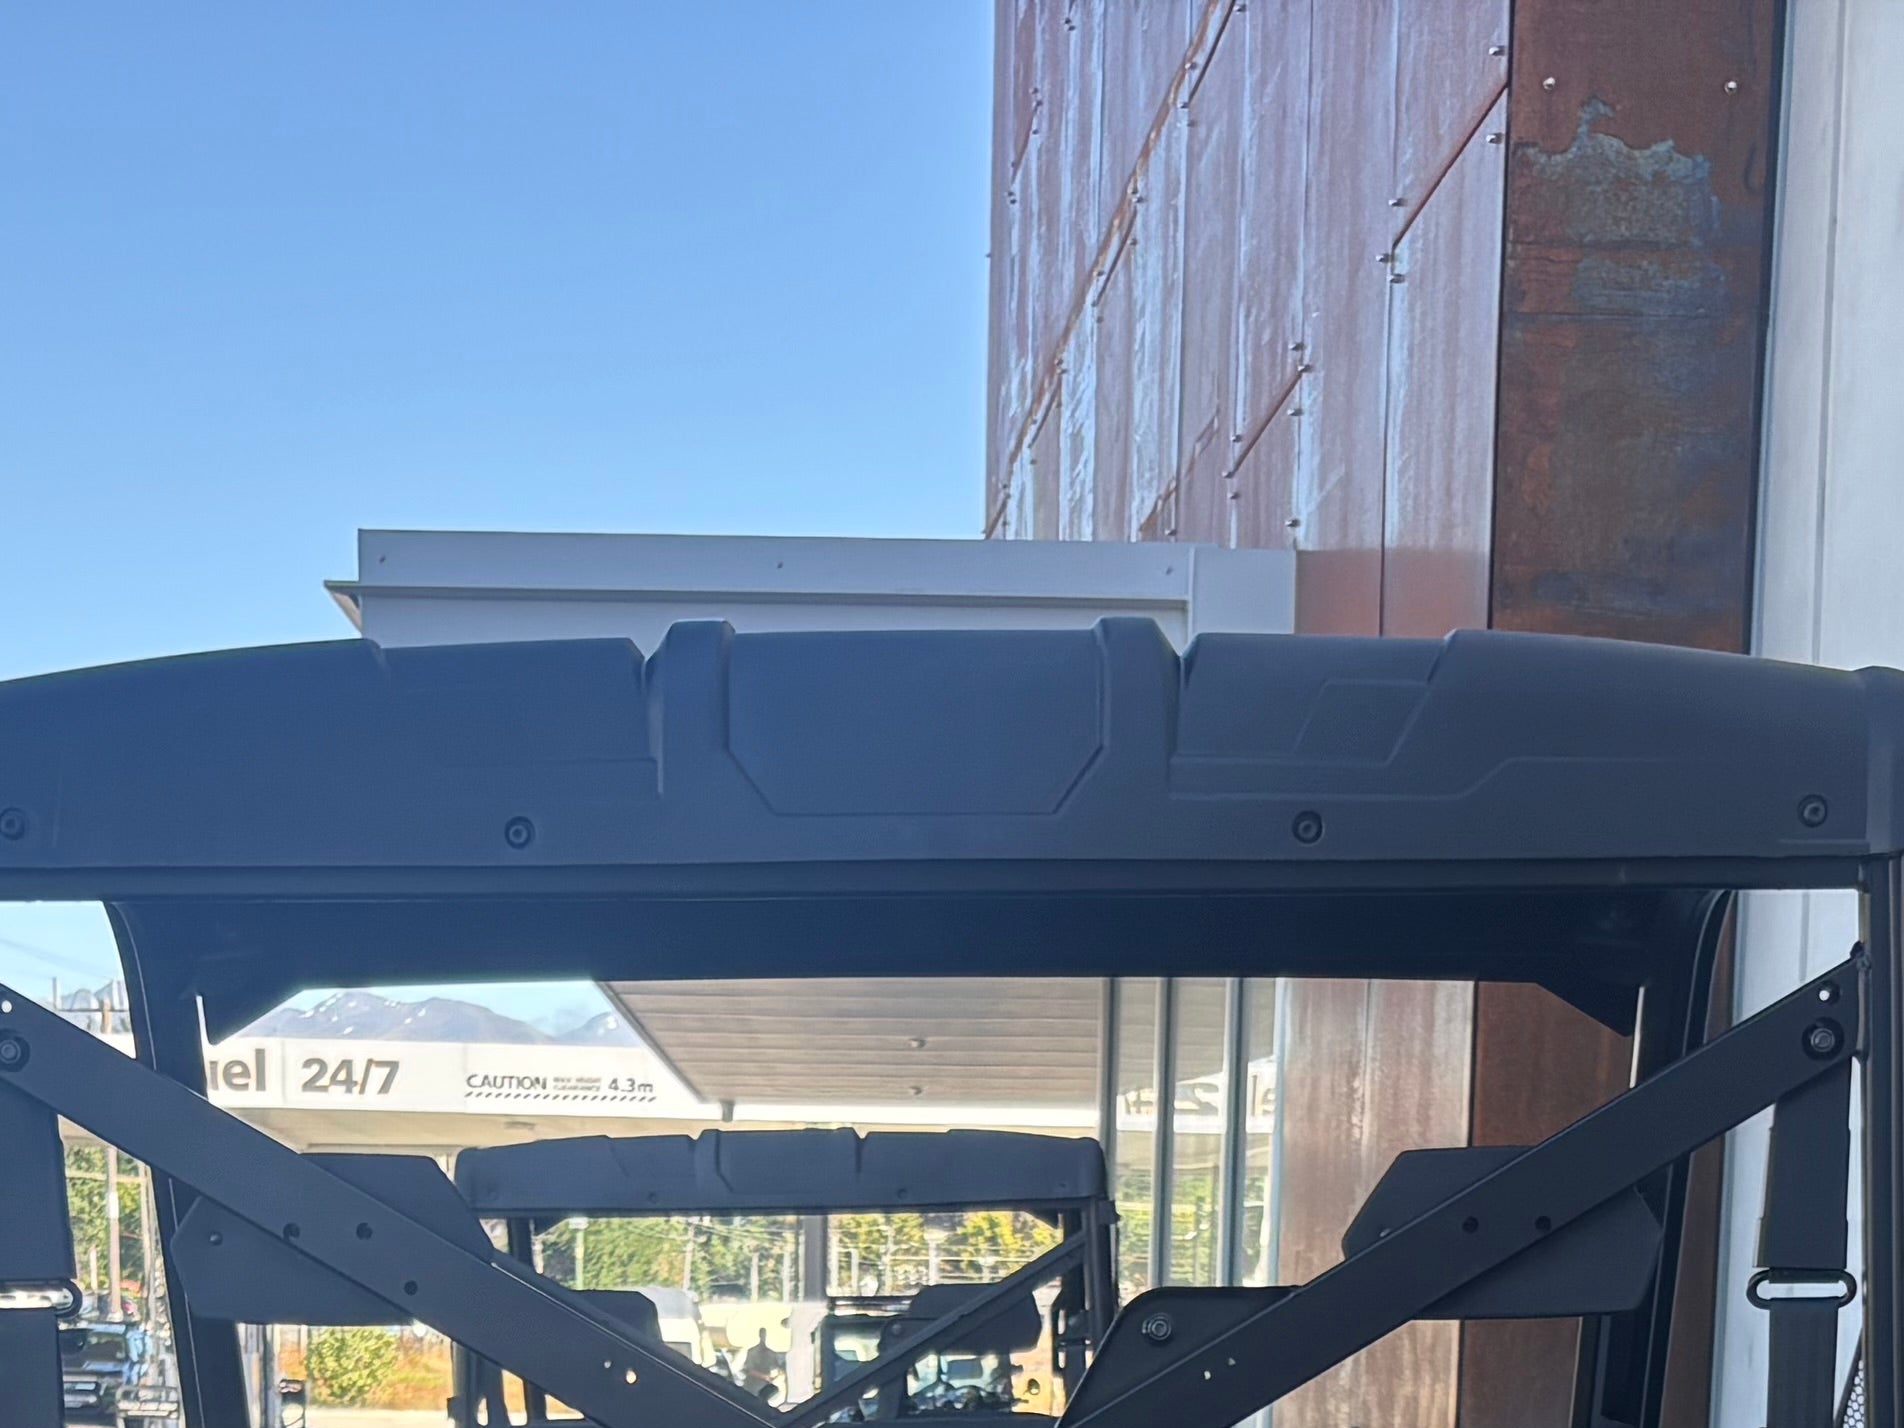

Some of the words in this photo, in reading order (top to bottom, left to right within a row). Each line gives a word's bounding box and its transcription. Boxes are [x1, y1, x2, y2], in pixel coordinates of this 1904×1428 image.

[301, 1057, 400, 1096] 24/7
[466, 1074, 547, 1091] CAUTION
[608, 1078, 654, 1093] 4.3m
